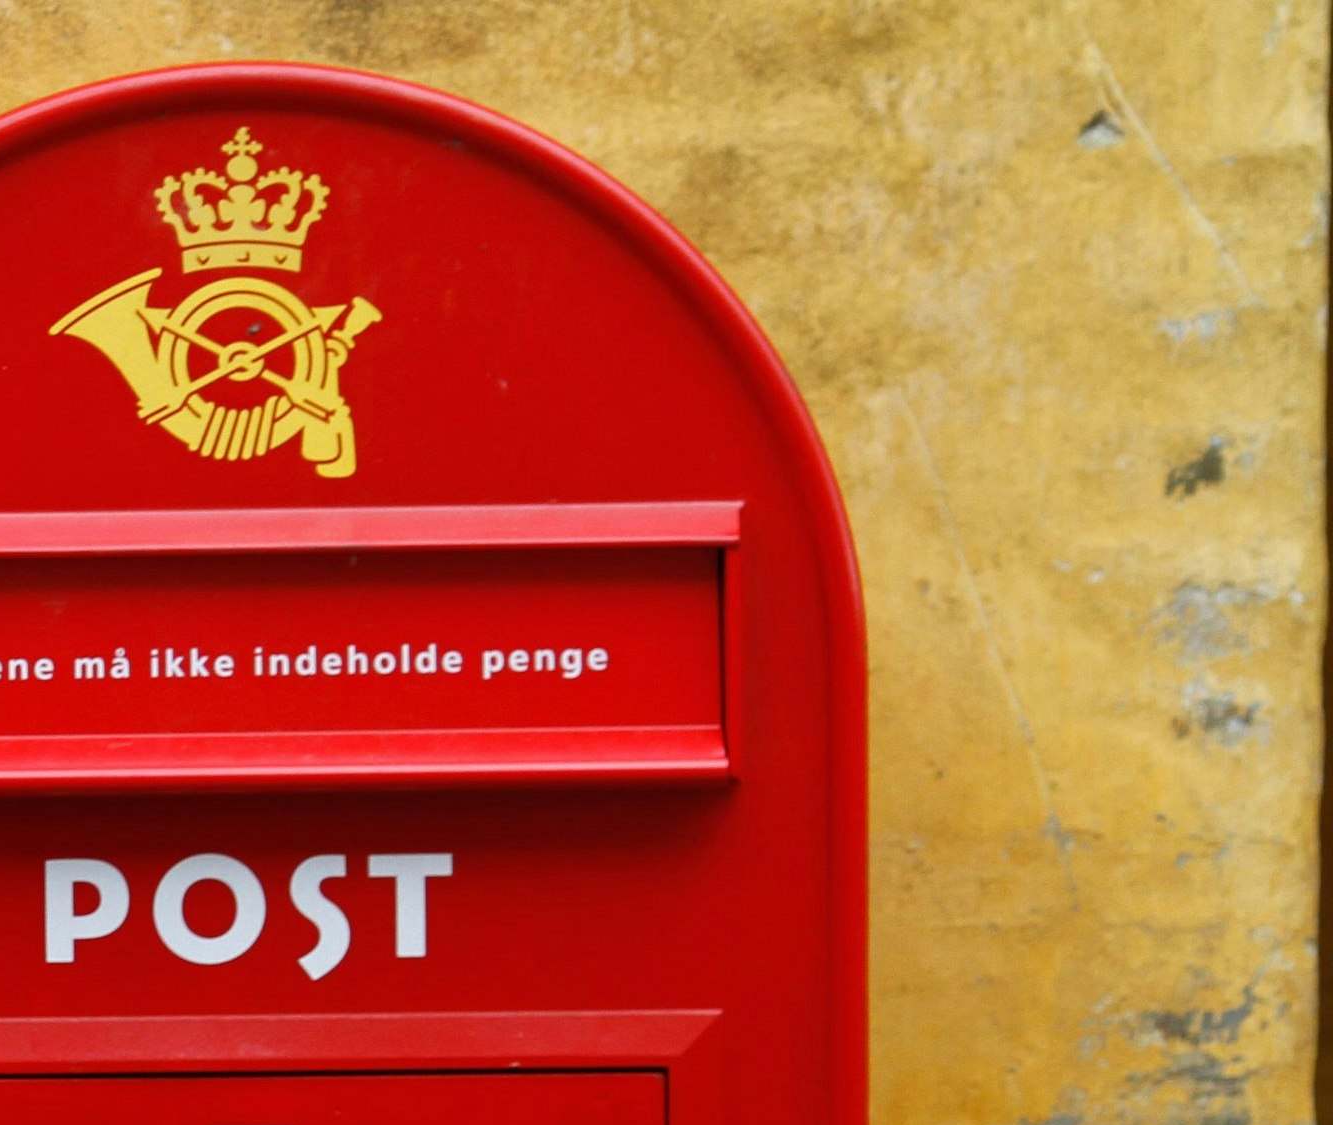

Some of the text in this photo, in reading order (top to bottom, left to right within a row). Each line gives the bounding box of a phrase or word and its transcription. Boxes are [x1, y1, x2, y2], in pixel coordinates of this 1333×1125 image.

[74, 649, 130, 678] må
[150, 648, 233, 678] ikke
[253, 645, 463, 677] indeholde
[482, 646, 609, 678] penge
[44, 853, 453, 981] POST
